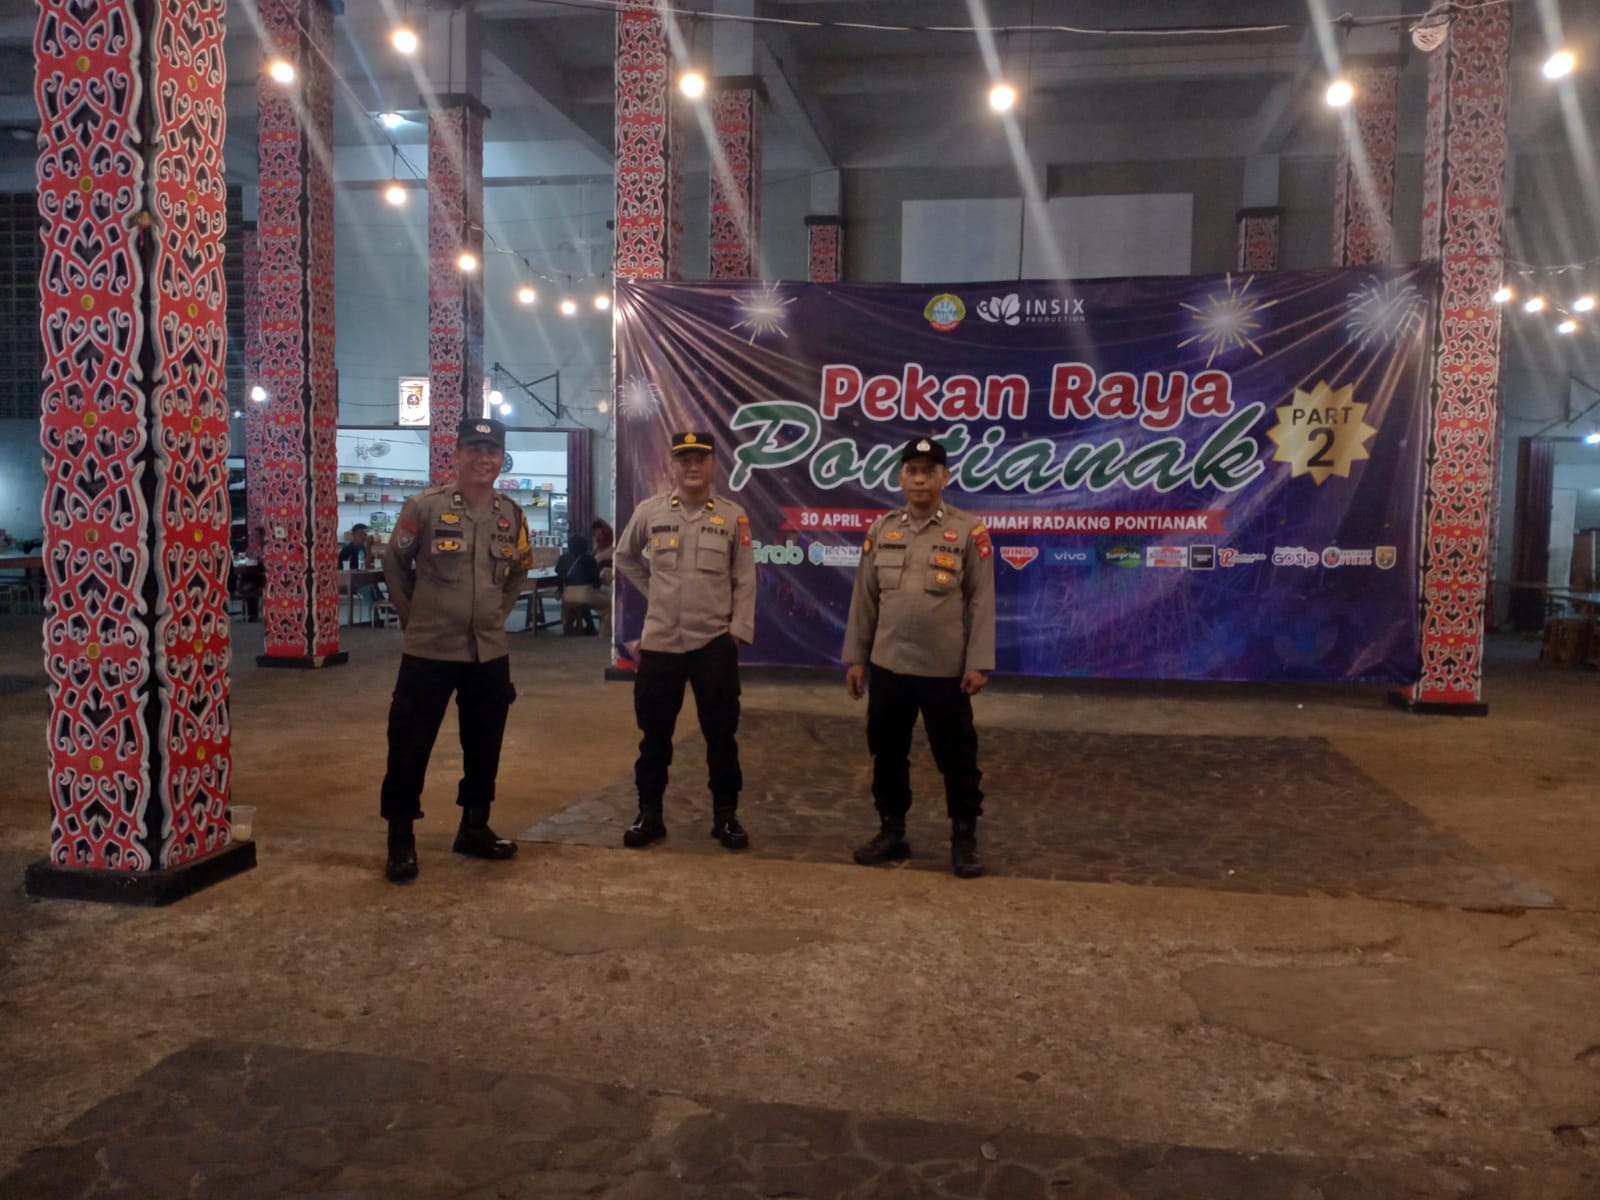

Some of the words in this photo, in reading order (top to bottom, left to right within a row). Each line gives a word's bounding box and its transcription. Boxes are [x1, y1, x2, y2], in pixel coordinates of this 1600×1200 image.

[1025, 299, 1084, 315] INSIX
[1025, 315, 1086, 323] PRODUCTION
[820, 363, 1029, 420] Pekan
[1049, 362, 1234, 431] Raya
[1292, 406, 1352, 426] PART
[728, 400, 1265, 492] Pontianak
[1307, 426, 1335, 468] 2
[800, 512, 819, 526] 30
[822, 513, 862, 527] APRIL
[977, 515, 1028, 529] UMAH
[1032, 515, 1109, 531] RADAKNG
[1113, 515, 1208, 530] PONTIANAK
[700, 526, 728, 536] POLRI
[1001, 547, 1037, 557] WINGS
[1054, 552, 1086, 561] vivo
